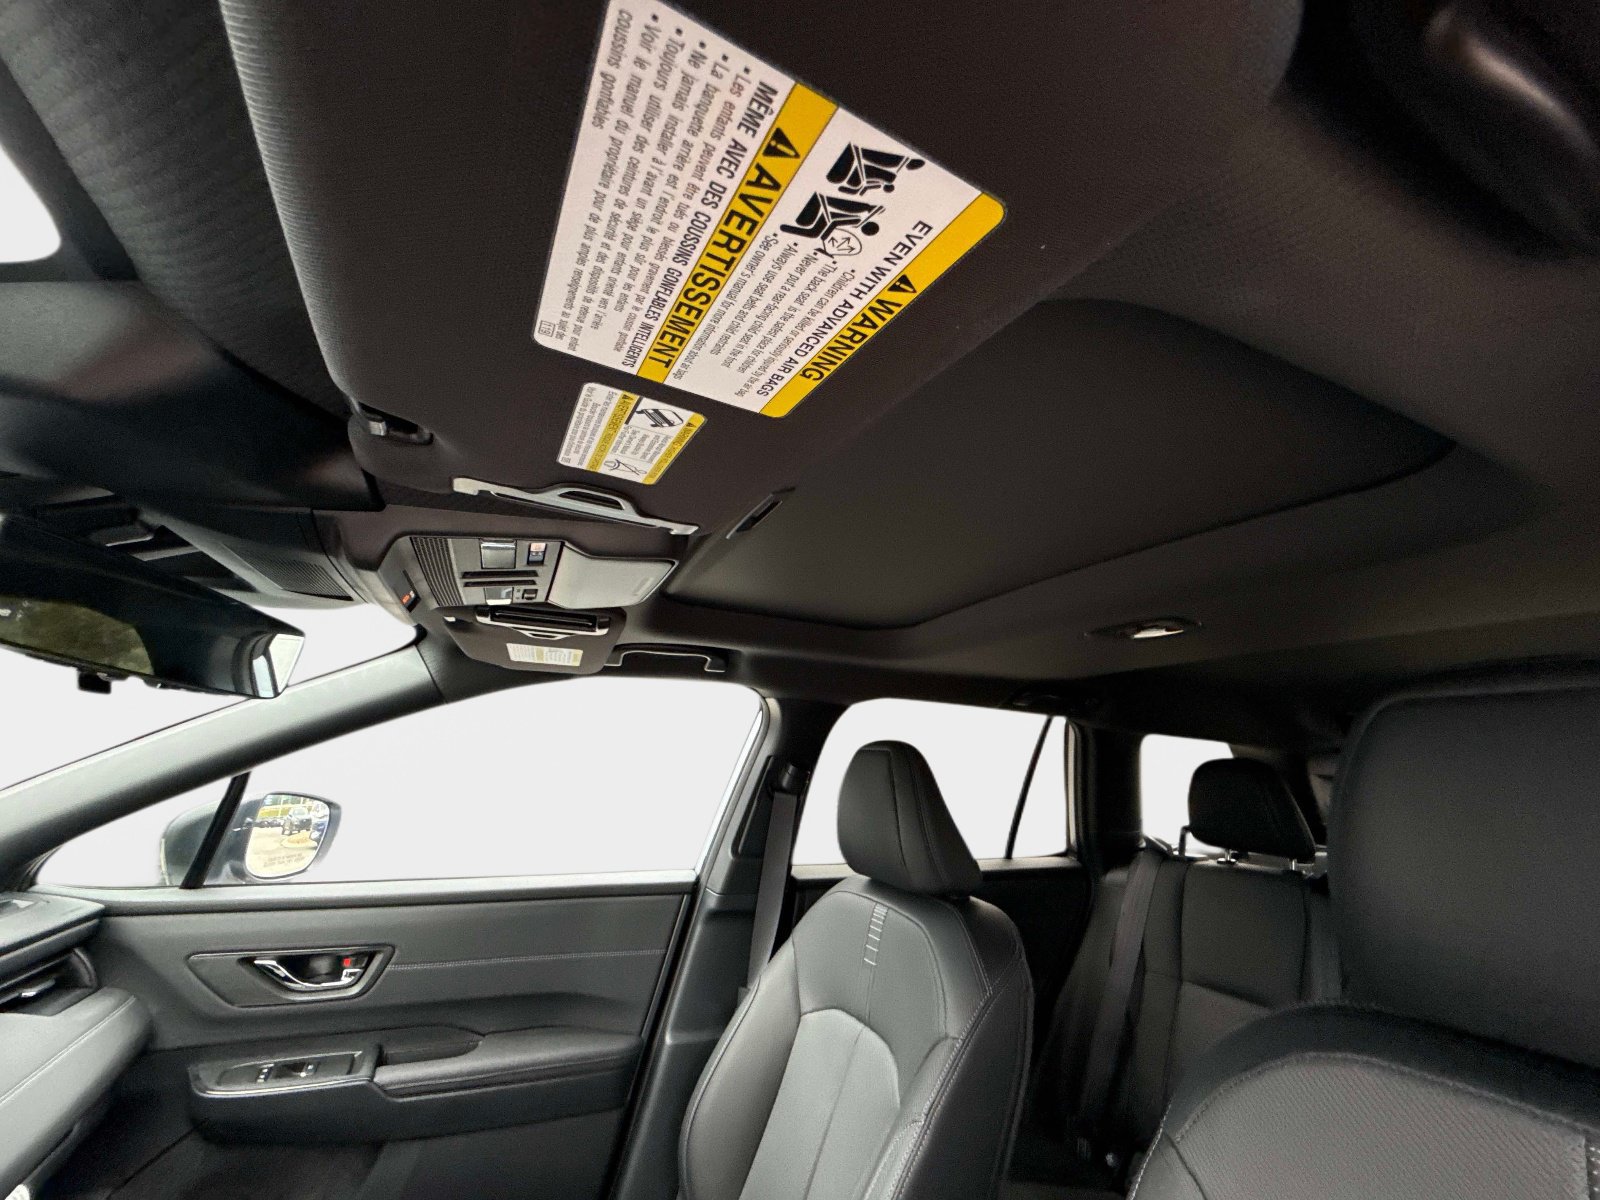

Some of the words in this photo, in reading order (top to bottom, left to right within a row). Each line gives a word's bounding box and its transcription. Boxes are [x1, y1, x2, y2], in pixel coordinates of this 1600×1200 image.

[606, 8, 633, 69] coussins
[639, 23, 662, 54] Voir
[632, 55, 651, 70] le
[652, 37, 686, 91] Toujours
[687, 49, 708, 69] Ne
[710, 61, 730, 80] La
[619, 73, 643, 118] manuel
[671, 69, 699, 112] jamais
[729, 73, 752, 98] Les
[591, 70, 617, 130] gonflables
[686, 81, 721, 137] banquette
[736, 80, 778, 138] MÊME
[639, 93, 662, 133] utiliser
[709, 100, 736, 141] enfants
[614, 119, 631, 135] du
[656, 113, 683, 156] installer
[631, 133, 650, 154] des
[597, 135, 623, 189] propriétaire
[672, 139, 694, 172] arrière
[691, 140, 716, 182] peuvent
[715, 137, 748, 179] AVEC
[617, 155, 641, 197] ceintures
[664, 173, 679, 190] est
[592, 188, 607, 212] pour
[682, 182, 701, 200] être
[700, 180, 728, 209] DES
[613, 197, 628, 210] de
[634, 197, 648, 210] un
[672, 201, 691, 220] tués
[588, 212, 602, 224] de
[602, 211, 623, 242] sécurité
[625, 210, 643, 232] siège
[667, 221, 680, 233] ou
[582, 223, 598, 242] plus
[645, 225, 660, 235] le
[671, 210, 712, 266] COUSSINS
[599, 241, 612, 251] et
[620, 231, 634, 251] pour
[638, 234, 654, 252] plus
[653, 235, 675, 262] blessés
[758, 235, 779, 252] See
[882, 220, 933, 266] EVEN
[575, 242, 591, 267] amples
[594, 250, 609, 264] des
[610, 251, 627, 276] enfants
[633, 252, 647, 266] sûr
[771, 243, 798, 271] Always
[793, 253, 819, 276] Never
[626, 264, 640, 282] pour
[648, 162, 782, 369] AVERTISSEMENT
[817, 263, 838, 277] The
[622, 281, 635, 292] les
[639, 261, 661, 295] gravement
[762, 269, 778, 284] use
[783, 272, 800, 288] put
[803, 275, 826, 293] back
[823, 271, 855, 299] Children
[849, 266, 891, 300] WITH
[634, 293, 646, 305] par
[644, 267, 683, 321] GONFLABLES
[725, 276, 748, 302] manual
[751, 281, 769, 297] seat
[793, 291, 810, 306] seat
[613, 292, 629, 313] enfants
[719, 299, 735, 310] for
[741, 295, 762, 311] belts
[754, 290, 787, 322] rear-facing
[807, 307, 822, 317] be
[813, 296, 829, 310] can
[709, 308, 727, 325] more
[734, 309, 749, 323] and
[779, 311, 795, 322] the
[794, 315, 815, 332] killed
[552, 328, 567, 341] des
[572, 323, 583, 337] pour
[692, 322, 720, 351] information
[725, 320, 741, 335] child
[747, 320, 764, 335] child
[765, 320, 786, 338] safest
[794, 298, 854, 357] ADVANCED
[621, 321, 655, 368] INTELLIGENTS
[709, 332, 732, 356] restraints
[738, 332, 754, 345] seat
[755, 334, 773, 350] place
[768, 335, 795, 358] seriously
[799, 298, 903, 381] WARNING
[683, 349, 699, 365] about
[750, 348, 764, 358] for
[736, 355, 757, 374] children
[777, 356, 799, 374] AIR
[756, 373, 785, 397] BAGS
